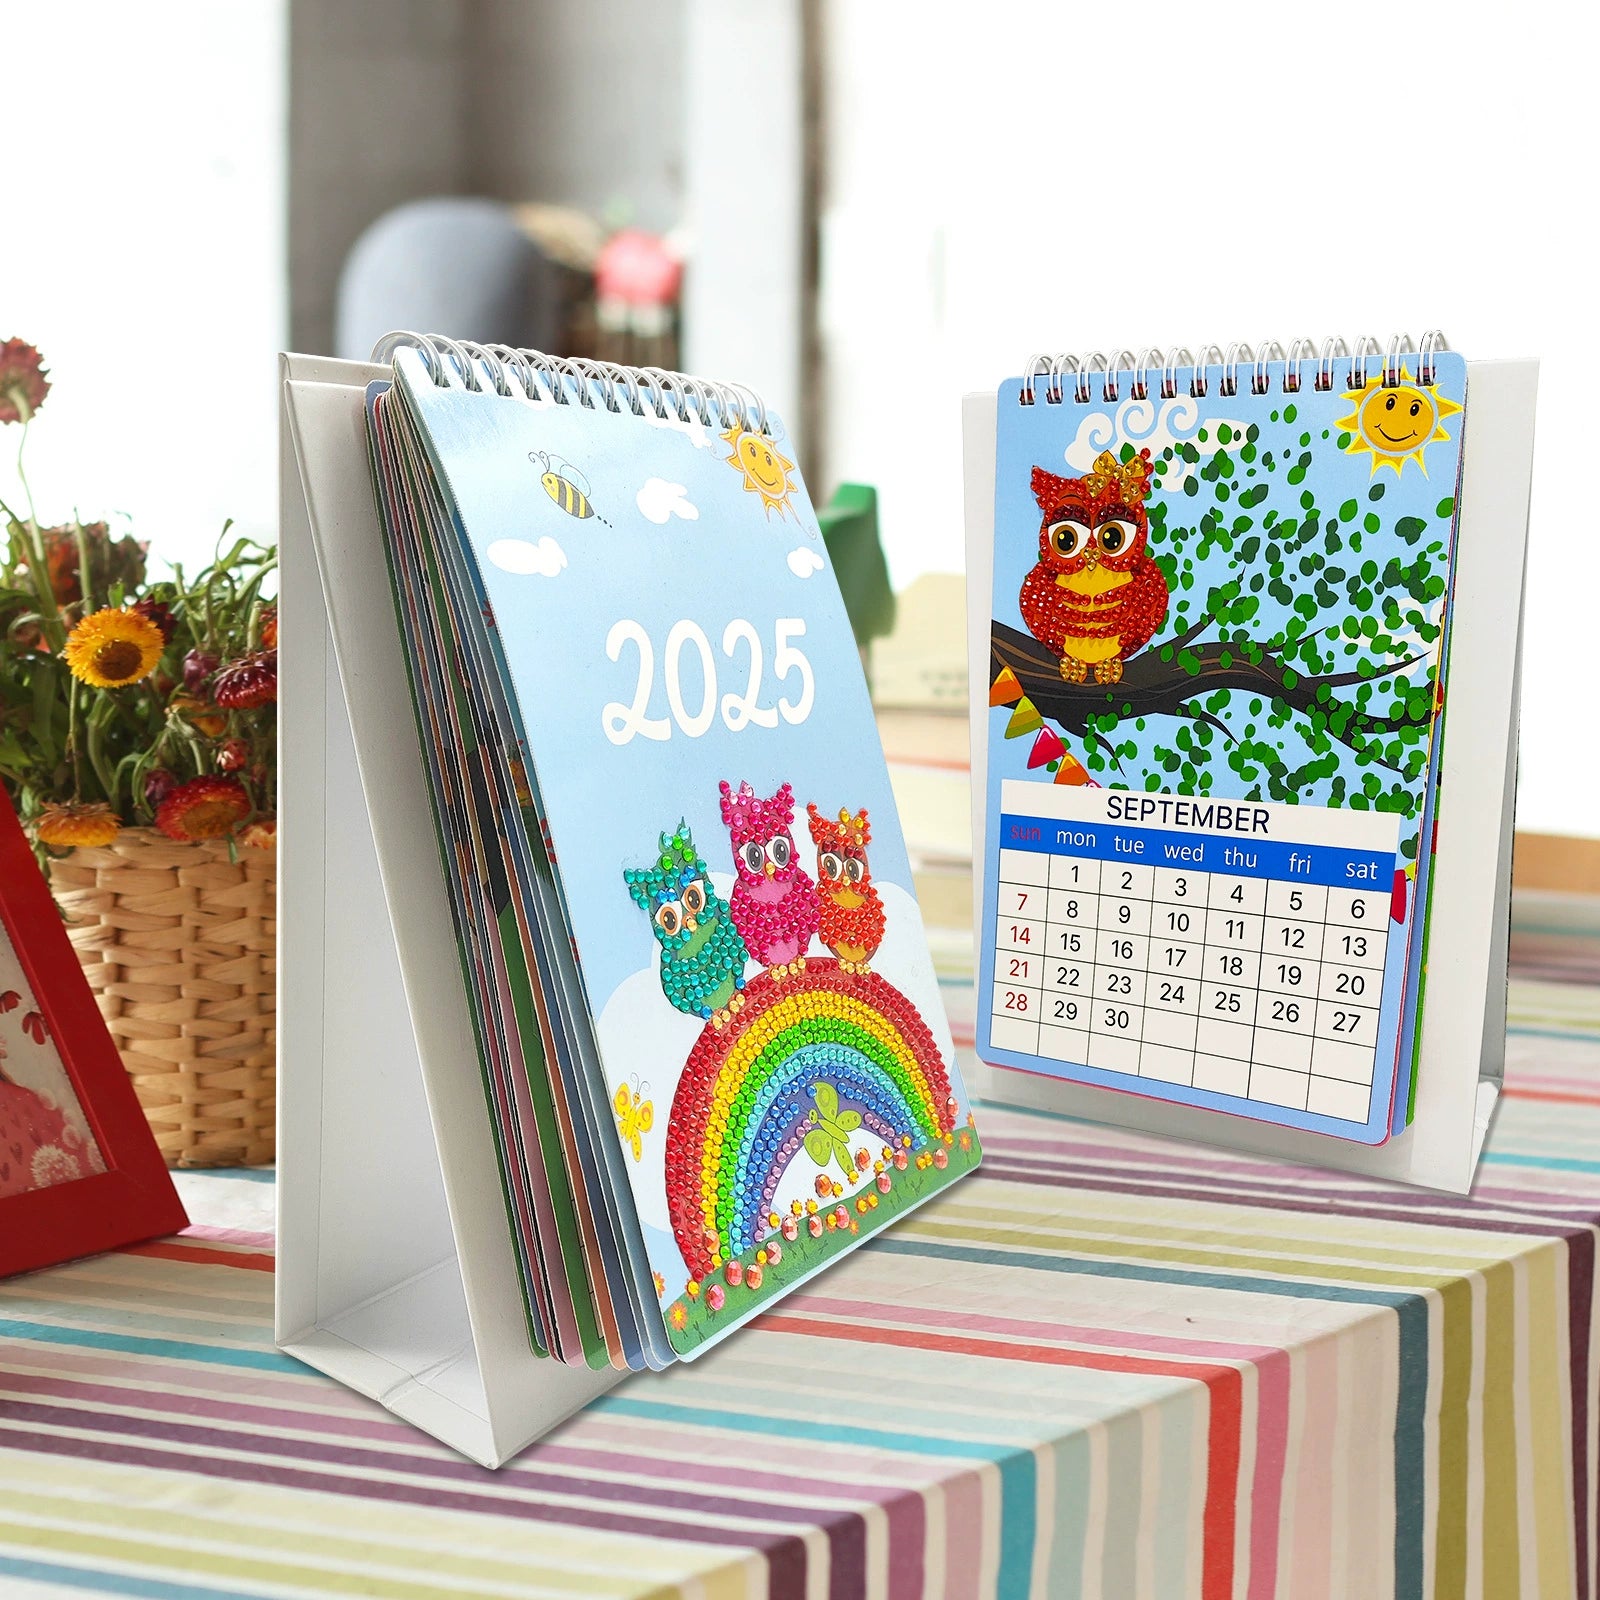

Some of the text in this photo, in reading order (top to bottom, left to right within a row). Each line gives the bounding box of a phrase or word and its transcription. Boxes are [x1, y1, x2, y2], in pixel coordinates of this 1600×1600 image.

[602, 618, 815, 745] 2025
[1106, 796, 1270, 834] SEPTEMBER
[1010, 825, 1378, 880] sun mon tue wed thu fri sat
[1017, 893, 1367, 958] 7 8 9 10 11 12 13
[1120, 871, 1133, 891] 2
[1174, 877, 1187, 897] 3
[1230, 884, 1244, 904] 4
[1289, 890, 1303, 911] 5
[1350, 898, 1366, 920] 6
[1010, 925, 1365, 996] 14 15 16 17 18 19 20
[1005, 991, 1130, 1029] 28 29 30
[1009, 958, 1362, 1033] 21 22 23 24 25 26 27
